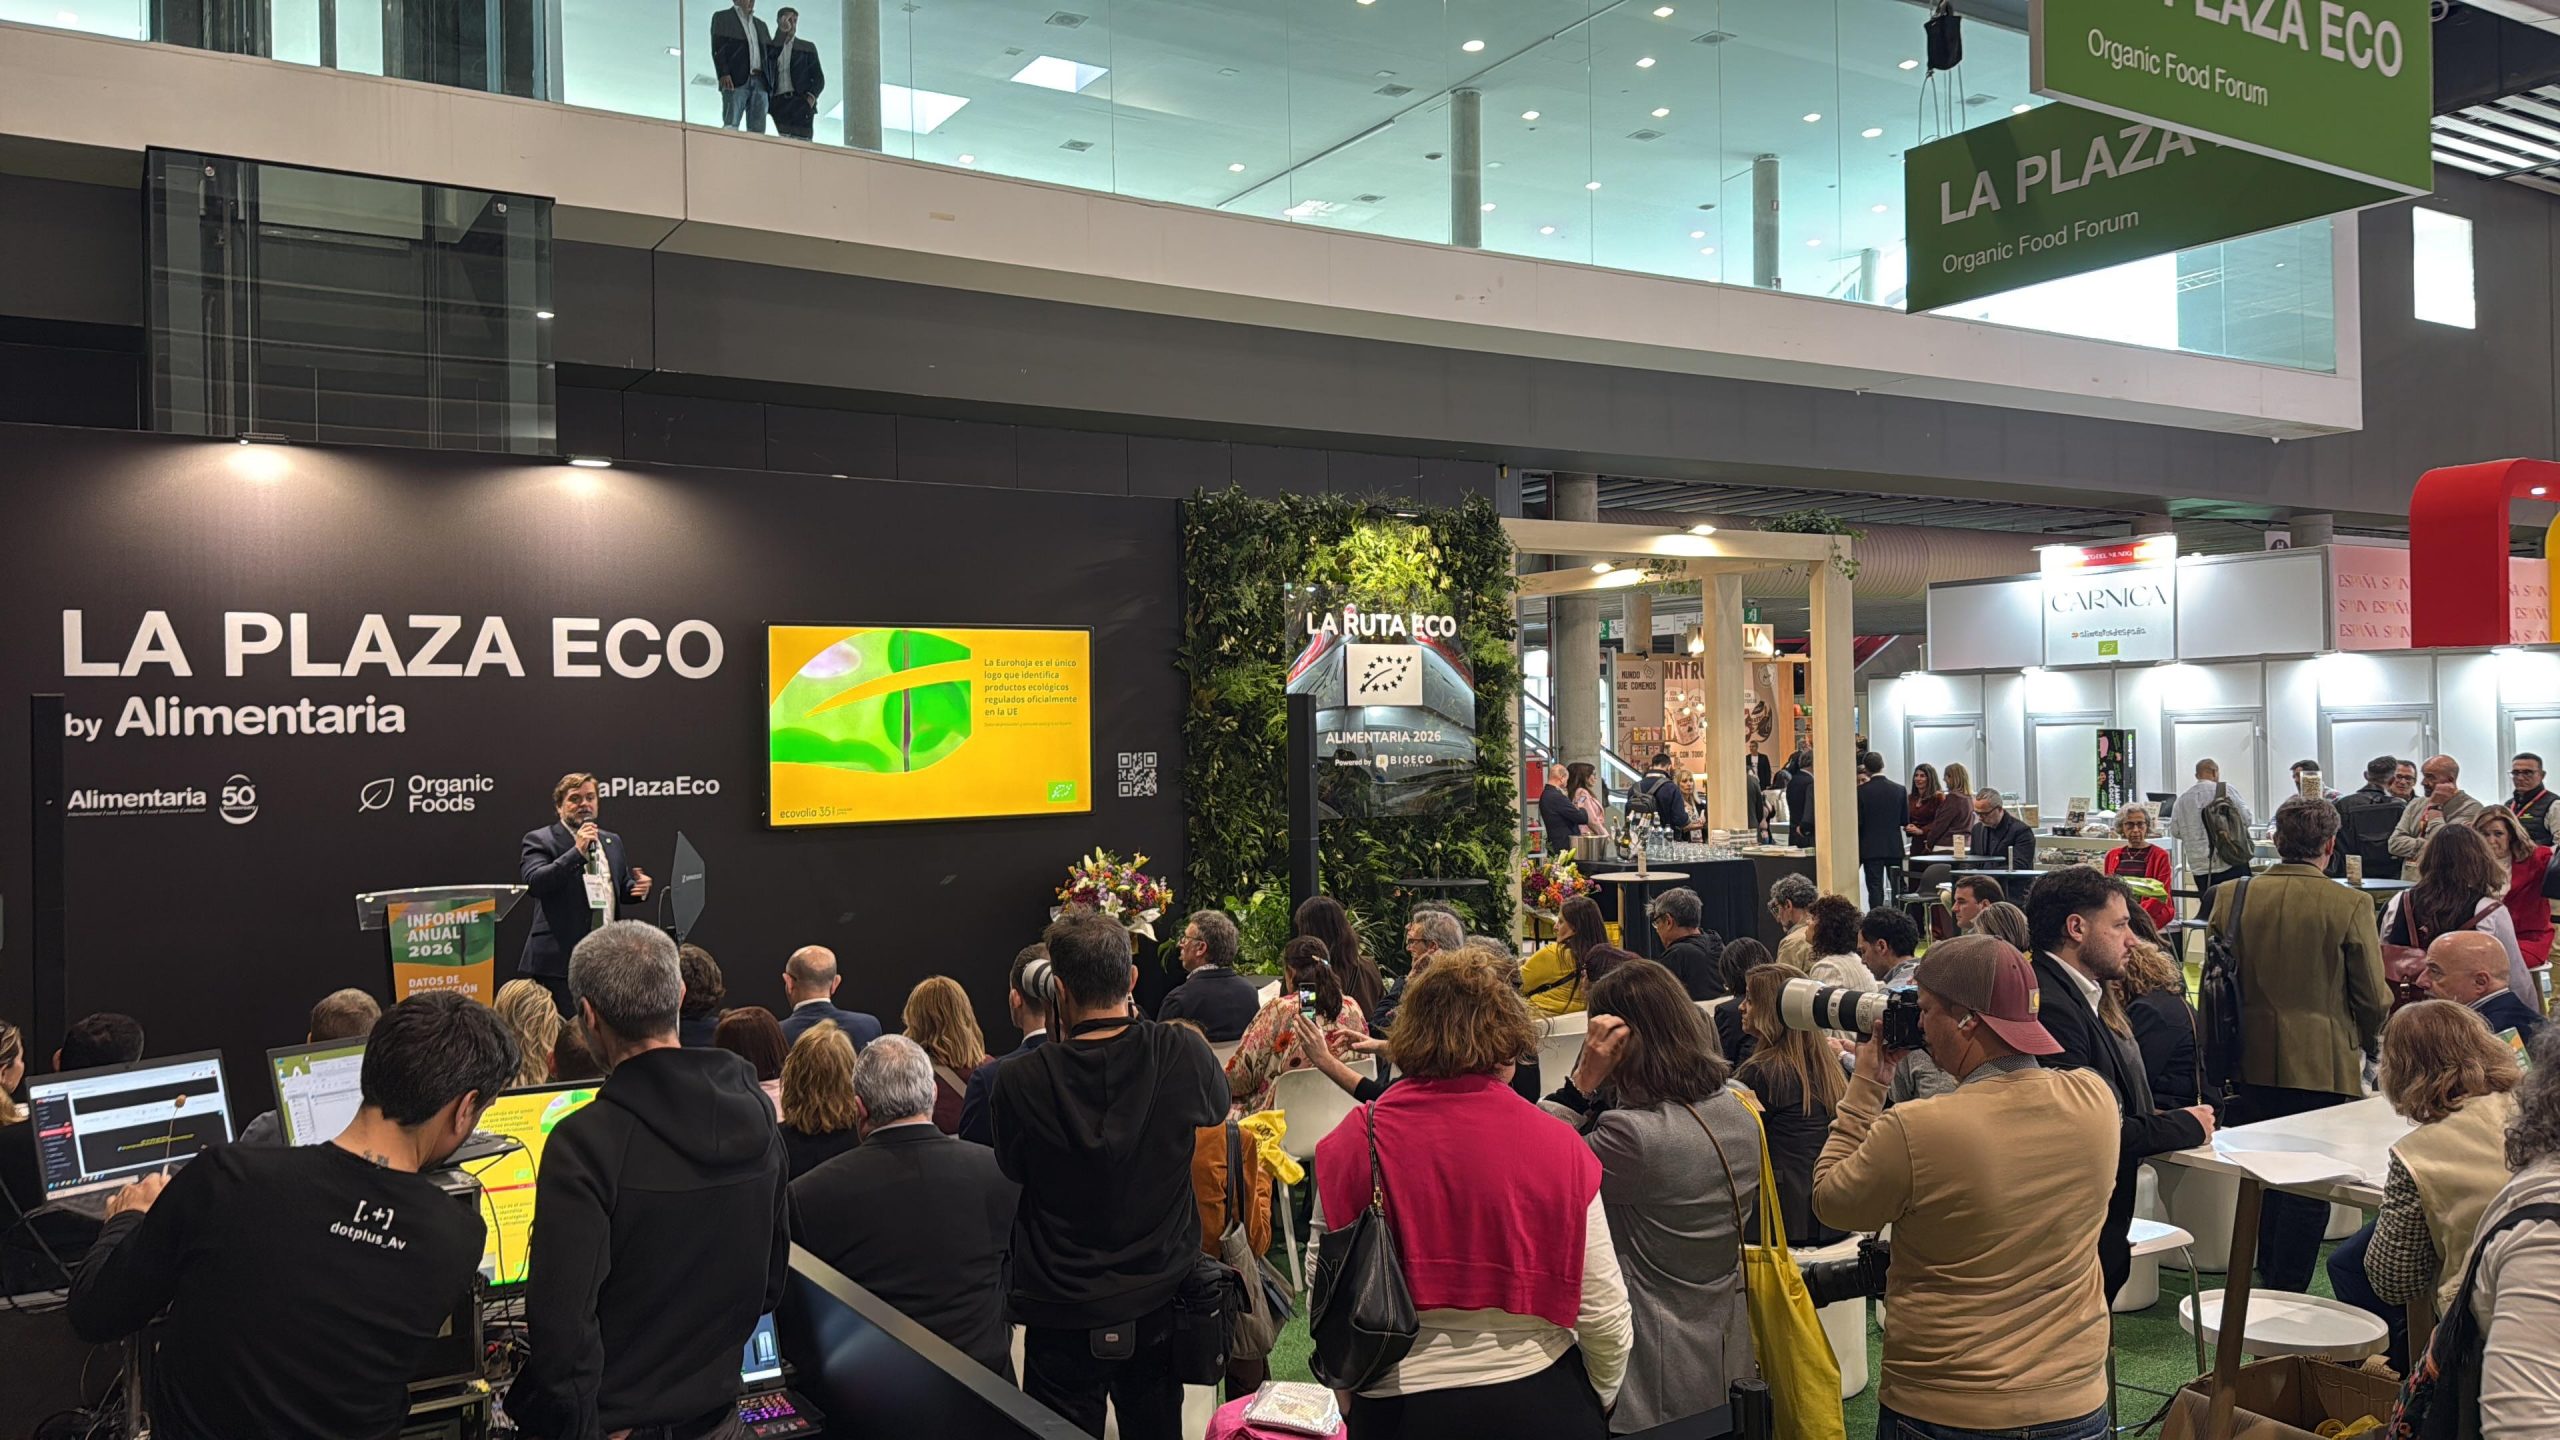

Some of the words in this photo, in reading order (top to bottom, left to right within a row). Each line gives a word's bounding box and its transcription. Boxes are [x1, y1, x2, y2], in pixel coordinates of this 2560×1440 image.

[2319, 1, 2402, 77] ECO
[2088, 28, 2161, 75] Organic
[2165, 52, 2210, 90] Food
[2215, 68, 2268, 107] Forum
[1941, 170, 2001, 225] LA
[2016, 124, 2197, 205] PLAZA
[1943, 242, 2013, 274] Organic
[2019, 226, 2067, 256] Food
[2075, 211, 2139, 241] Forum
[1307, 612, 1339, 636] LA
[1343, 612, 1407, 637] RUTA
[1412, 612, 1457, 638] ECO
[63, 609, 194, 677] LA
[224, 611, 526, 677] PLAZA
[553, 617, 724, 679] ECO
[996, 658, 1032, 668] Eurohoja
[1046, 658, 1053, 667] el
[984, 671, 1001, 680] logo
[1003, 672, 1019, 680] que
[1021, 670, 1060, 679] identifica
[1621, 671, 1641, 679] MUNDO
[984, 683, 1026, 693] productos
[1028, 683, 1069, 692] ecológicos
[1630, 681, 1657, 690] COMEMOS
[984, 695, 1025, 705] regulados
[1027, 694, 1077, 703] oficialmente
[65, 713, 103, 742] by
[115, 694, 406, 738] Alimentaria
[997, 707, 1005, 716] la
[1007, 708, 1018, 716] UE
[1325, 731, 1411, 745] ALIMENTARIA
[1413, 730, 1442, 743] 2026
[1335, 758, 1362, 767] Powered
[1364, 758, 1372, 768] by
[1390, 755, 1433, 765] BIOECO
[408, 773, 494, 797] Organic
[598, 775, 720, 798] aPlazaEco
[67, 787, 207, 810] Alimentaria
[409, 793, 475, 813] Foods
[780, 808, 817, 819] ecovalia
[407, 909, 480, 928] INFORME
[407, 926, 461, 943] ANUAL
[408, 942, 453, 958] 2026
[408, 976, 444, 988] DATOS
[446, 974, 459, 984] DE
